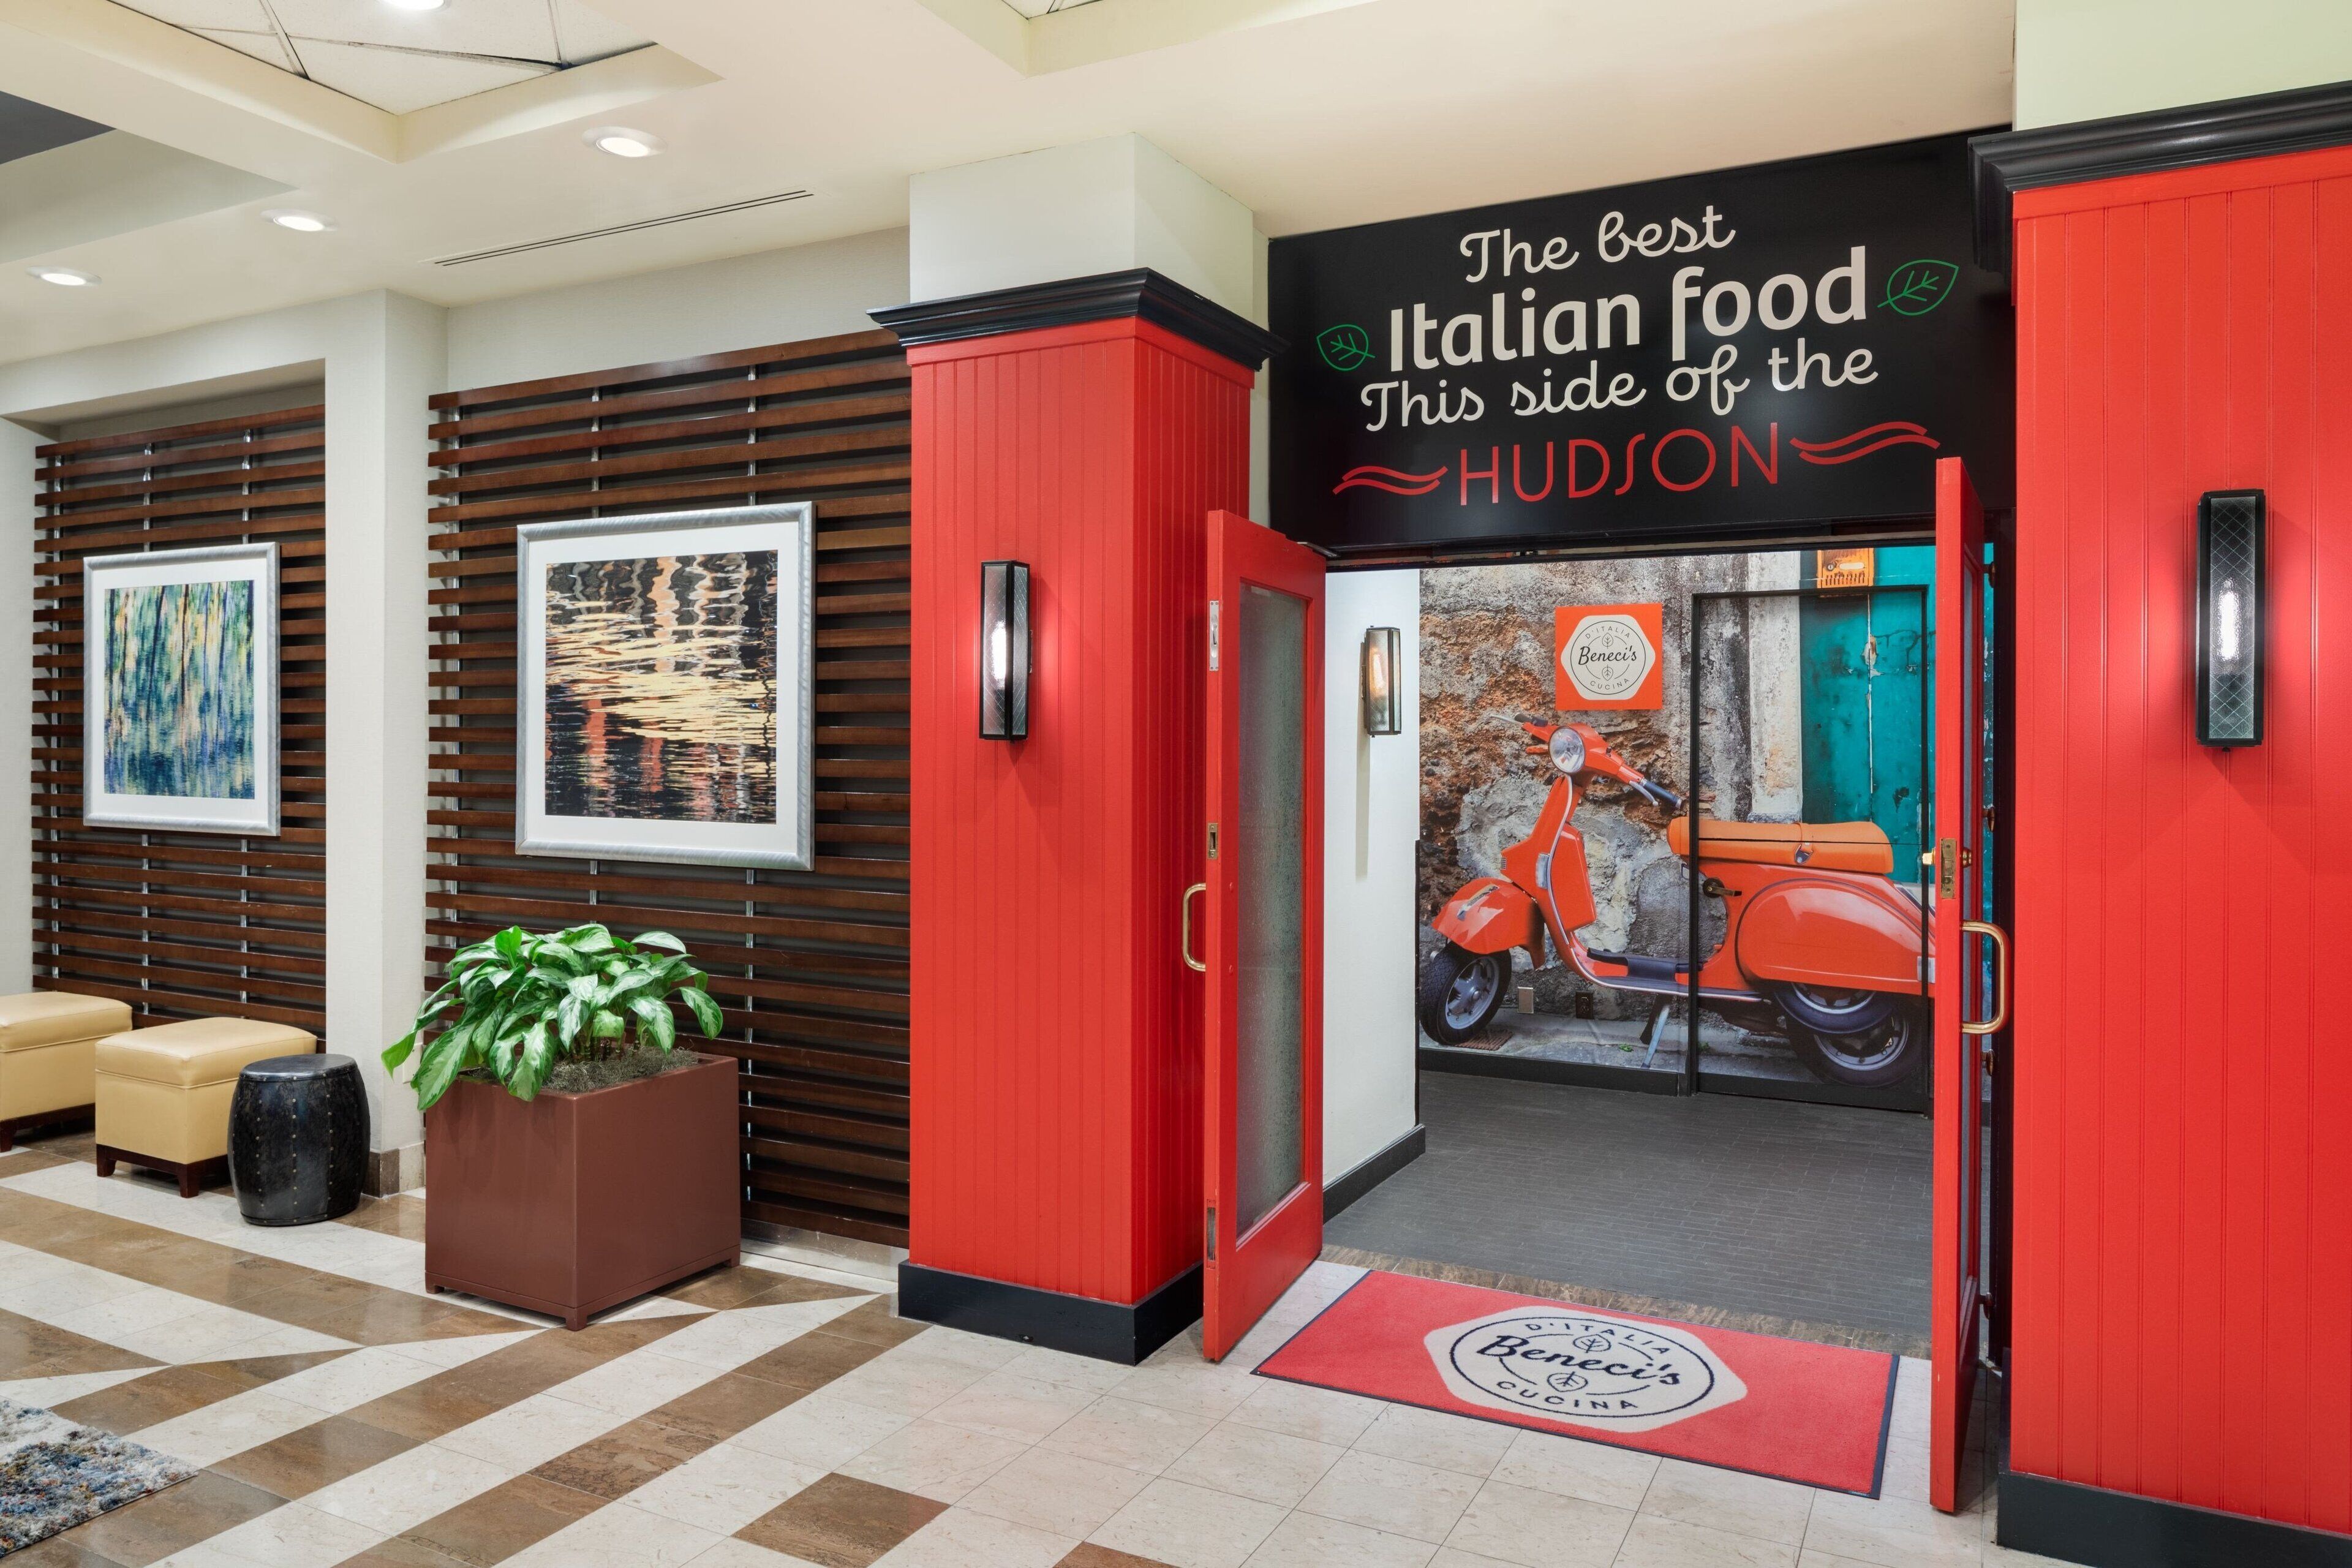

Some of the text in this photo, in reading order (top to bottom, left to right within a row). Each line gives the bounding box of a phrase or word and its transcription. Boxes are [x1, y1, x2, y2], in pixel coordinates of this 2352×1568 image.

[1460, 205, 1736, 283] The best
[1390, 245, 1866, 372] Italian food
[1360, 337, 1879, 432] This side of the
[1460, 422, 1778, 506] HUDSON
[1578, 645, 1637, 666] Beneci's
[1590, 678, 1629, 690] CUCINA
[1476, 1335, 1681, 1385] Beneci's
[1525, 1323, 1670, 1355] D'ITALIA
[1496, 1381, 1638, 1409] CUCINA
